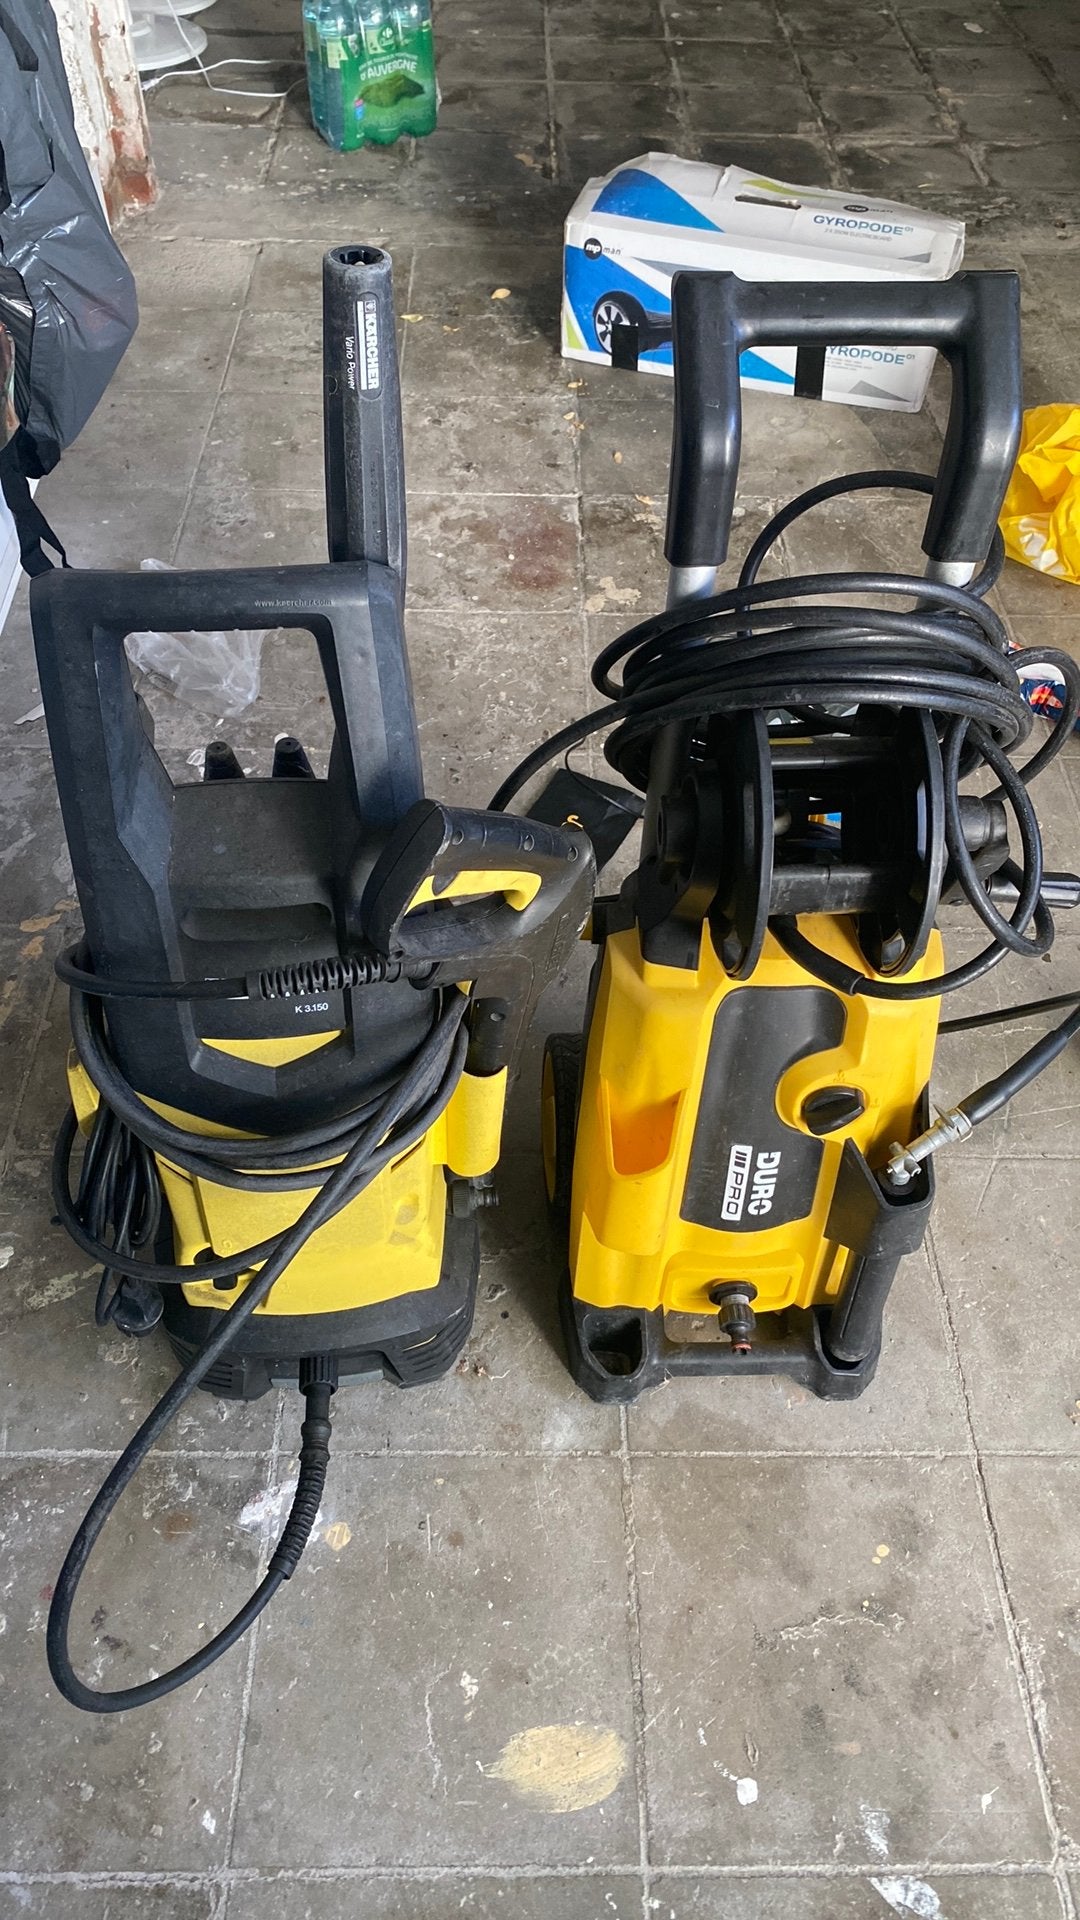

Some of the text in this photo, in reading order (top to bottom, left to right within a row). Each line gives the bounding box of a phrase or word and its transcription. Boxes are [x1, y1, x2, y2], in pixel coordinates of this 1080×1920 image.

[813, 215, 904, 235] GYROPODE
[345, 336, 356, 390] Vario Power
[826, 346, 905, 365] YROPODE
[304, 1002, 328, 1012] 3.150
[726, 1171, 744, 1215] PRO
[747, 1151, 781, 1215] DURO
